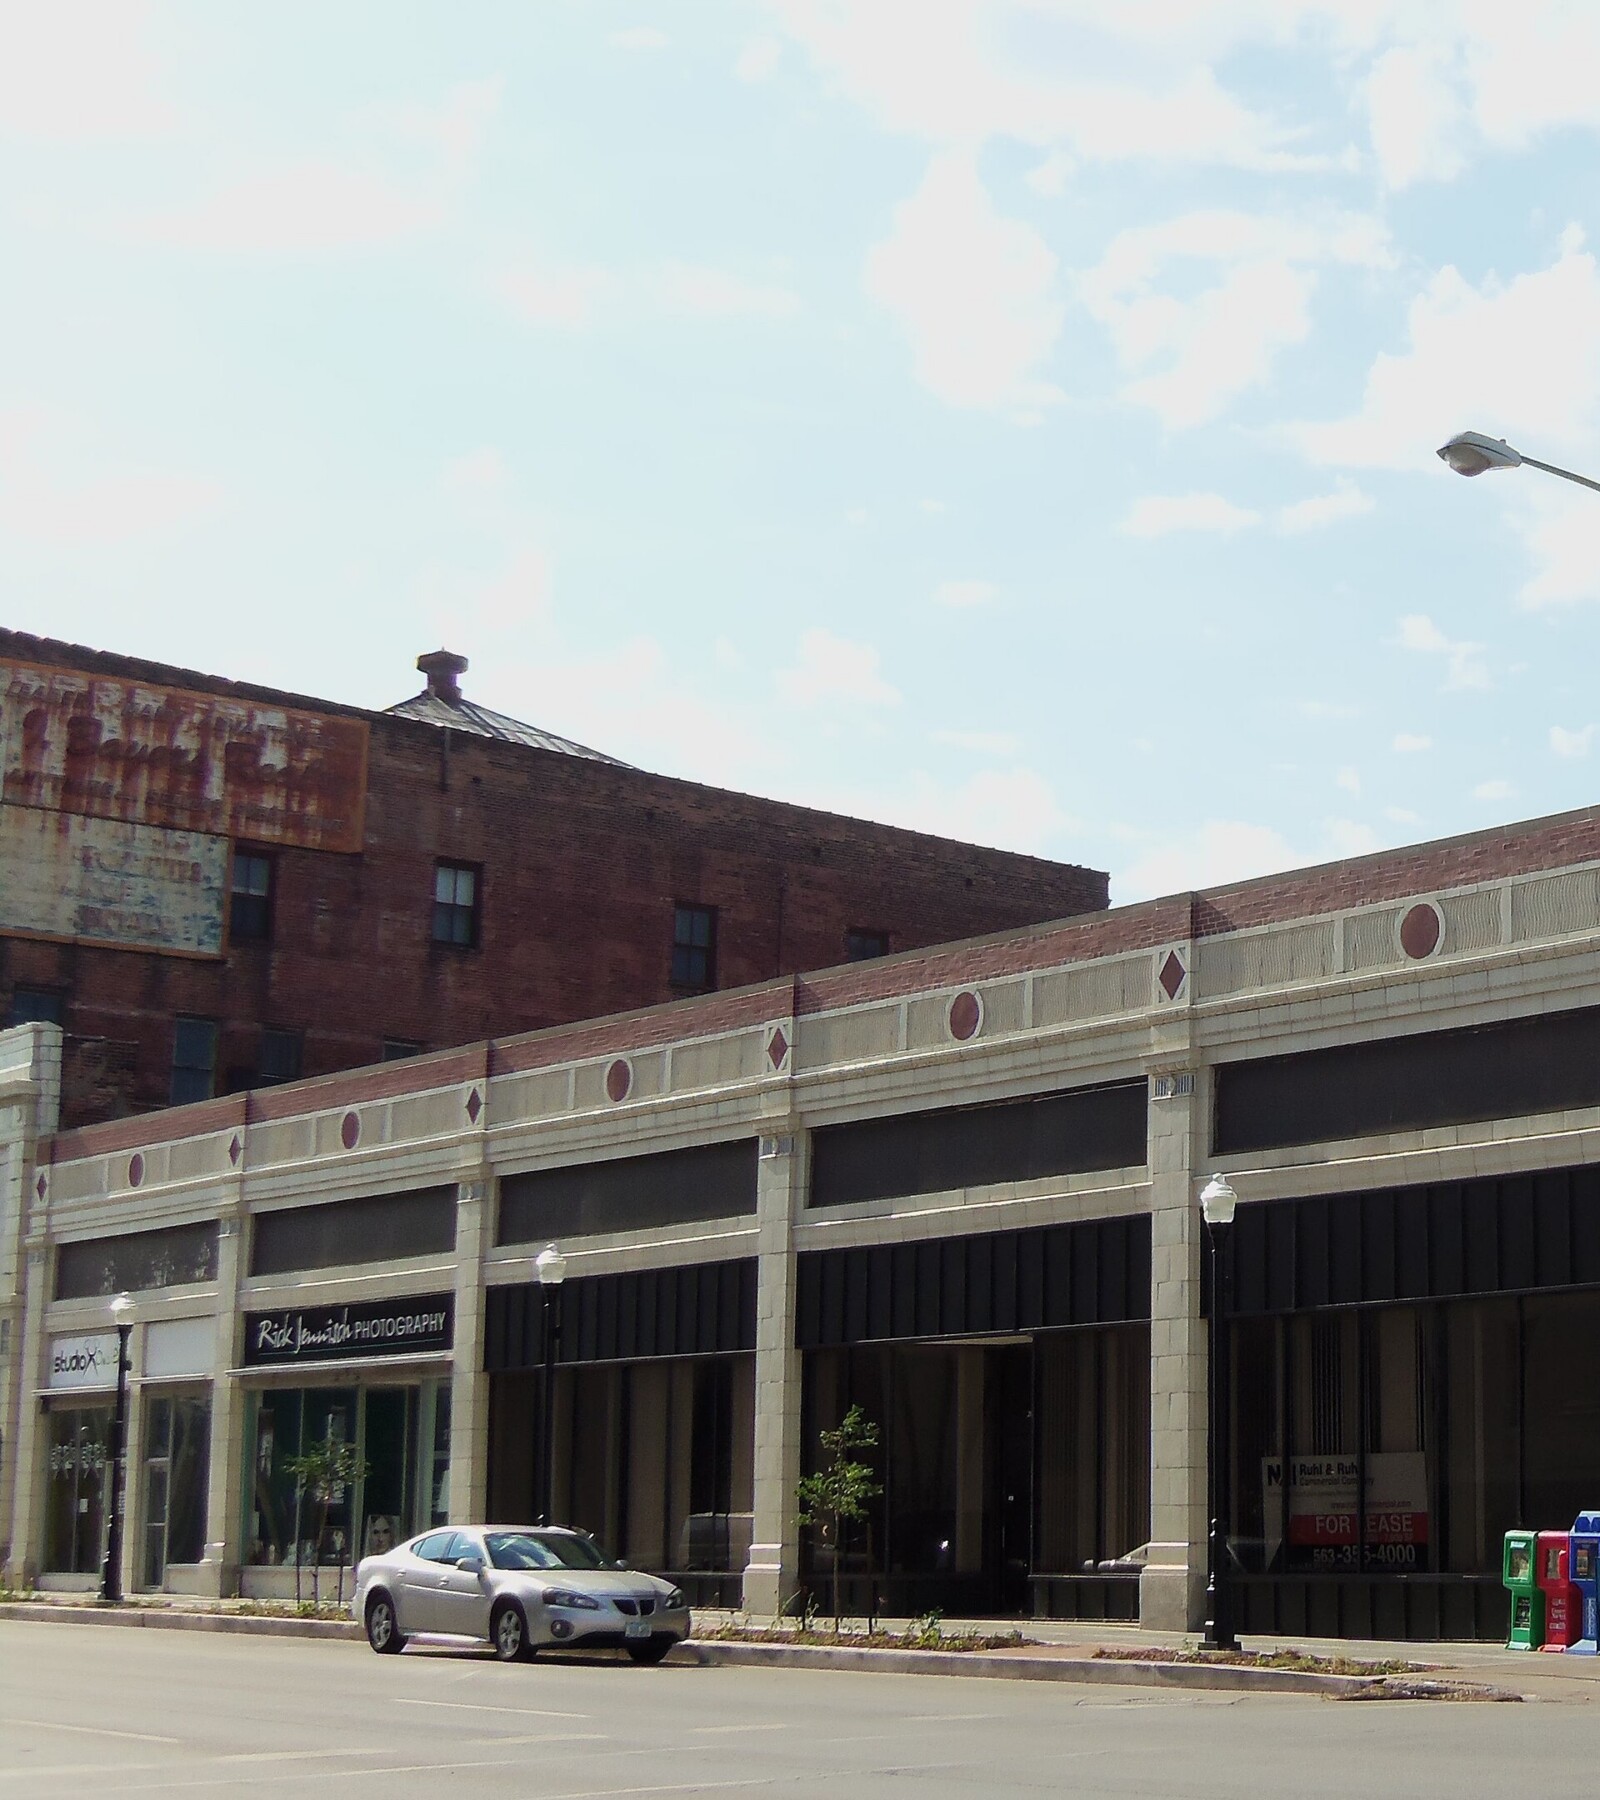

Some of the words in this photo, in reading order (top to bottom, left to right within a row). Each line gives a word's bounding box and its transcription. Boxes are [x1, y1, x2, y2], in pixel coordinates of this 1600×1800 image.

[258, 1313, 294, 1349] Rick
[353, 1312, 446, 1340] PHOTOGRAPHY
[1267, 1463, 1296, 1486] NI
[1325, 1463, 1334, 1475] &
[1337, 1462, 1359, 1475] Ruh
[1315, 1515, 1351, 1534] FOR
[1363, 1514, 1413, 1533] EASE
